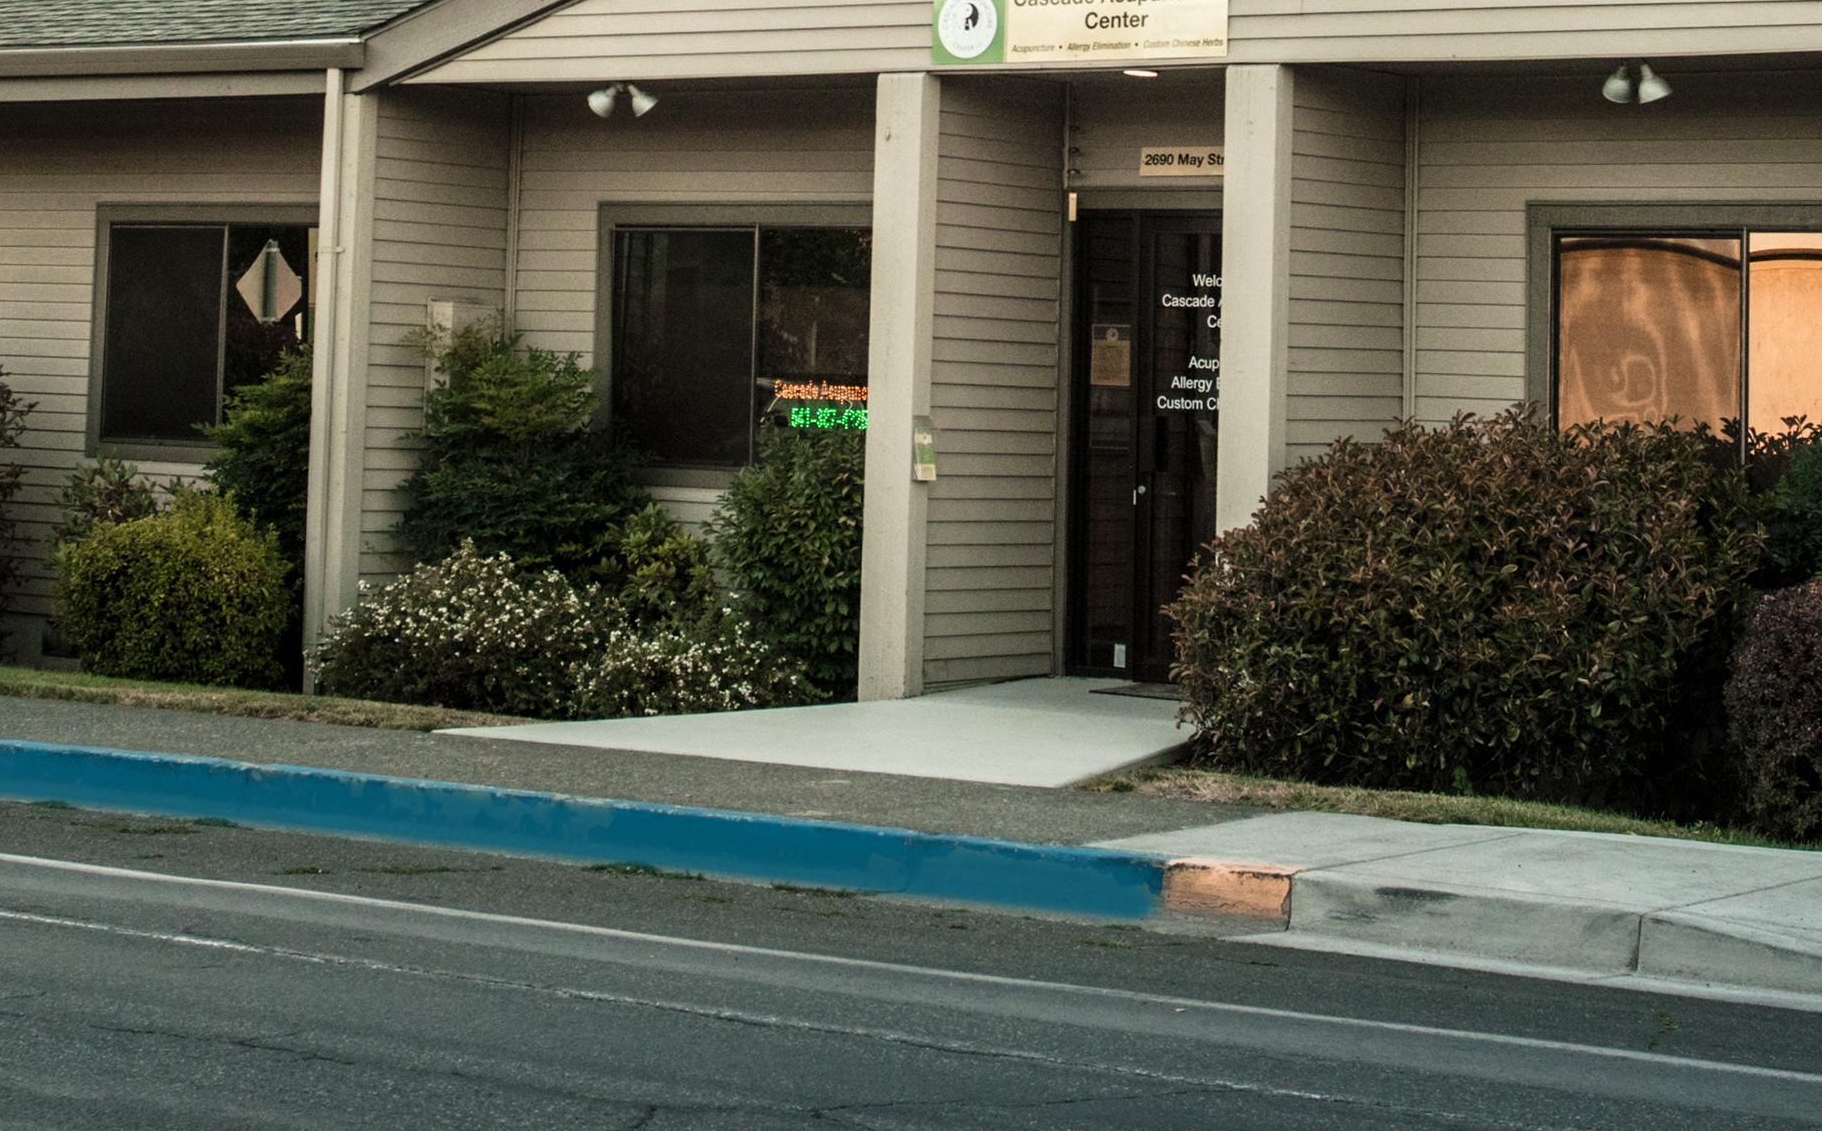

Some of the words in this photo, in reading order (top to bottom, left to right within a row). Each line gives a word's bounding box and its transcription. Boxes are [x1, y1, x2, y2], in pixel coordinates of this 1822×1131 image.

[1084, 11, 1149, 29] Center
[1011, 43, 1055, 53] Acupuncture
[1066, 41, 1091, 52] Allergy
[1092, 41, 1131, 51] Elimination
[1143, 39, 1171, 49] Custom
[1172, 38, 1201, 48] Chinese
[1202, 37, 1224, 47] Herbs
[1144, 153, 1175, 166] 2690
[1177, 153, 1205, 168] May
[1207, 153, 1224, 166] Str
[1192, 273, 1222, 288] Welc
[1162, 293, 1216, 308] Cascade
[1170, 375, 1213, 393] Allergy
[819, 379, 868, 405] Acupunc
[1157, 395, 1204, 410] Custom
